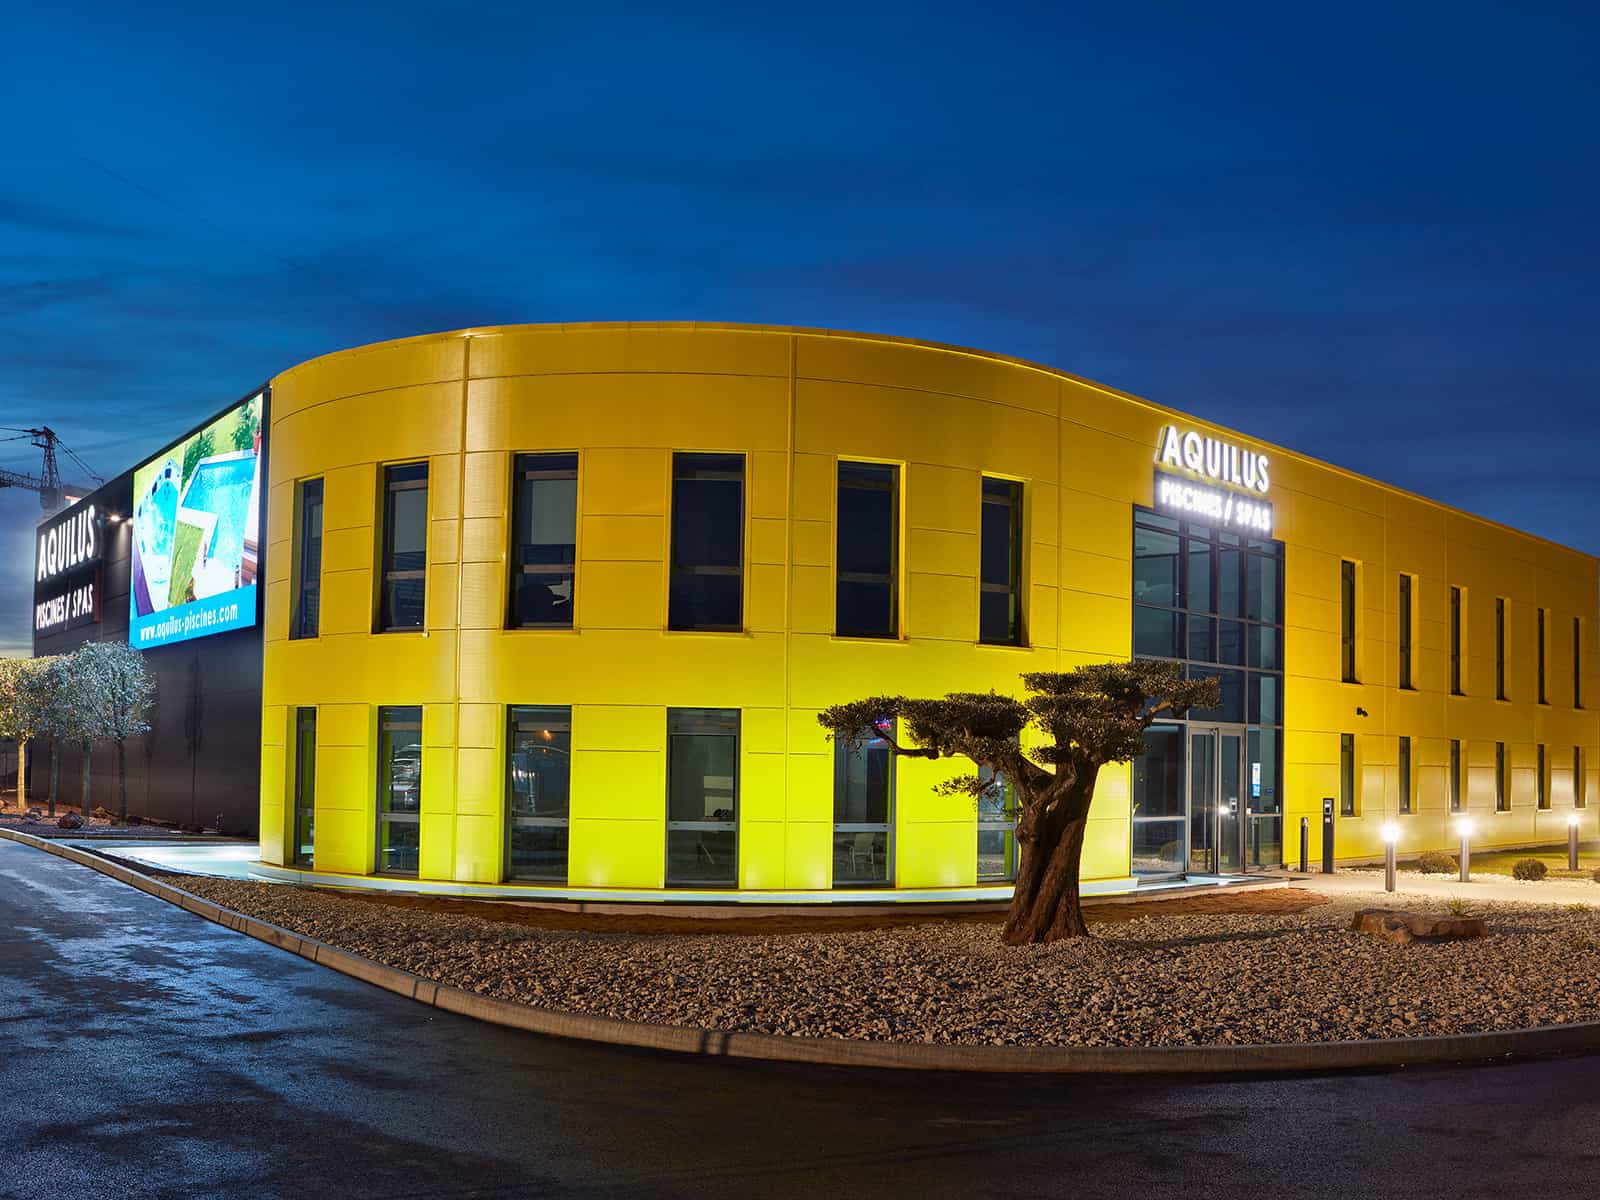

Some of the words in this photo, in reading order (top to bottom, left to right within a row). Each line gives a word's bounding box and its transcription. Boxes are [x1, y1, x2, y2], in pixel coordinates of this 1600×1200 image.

[1158, 425, 1269, 493] AQUILUS
[1236, 500, 1271, 531] SPAS
[37, 504, 96, 582] AQUILUS
[72, 583, 94, 618] SPAS
